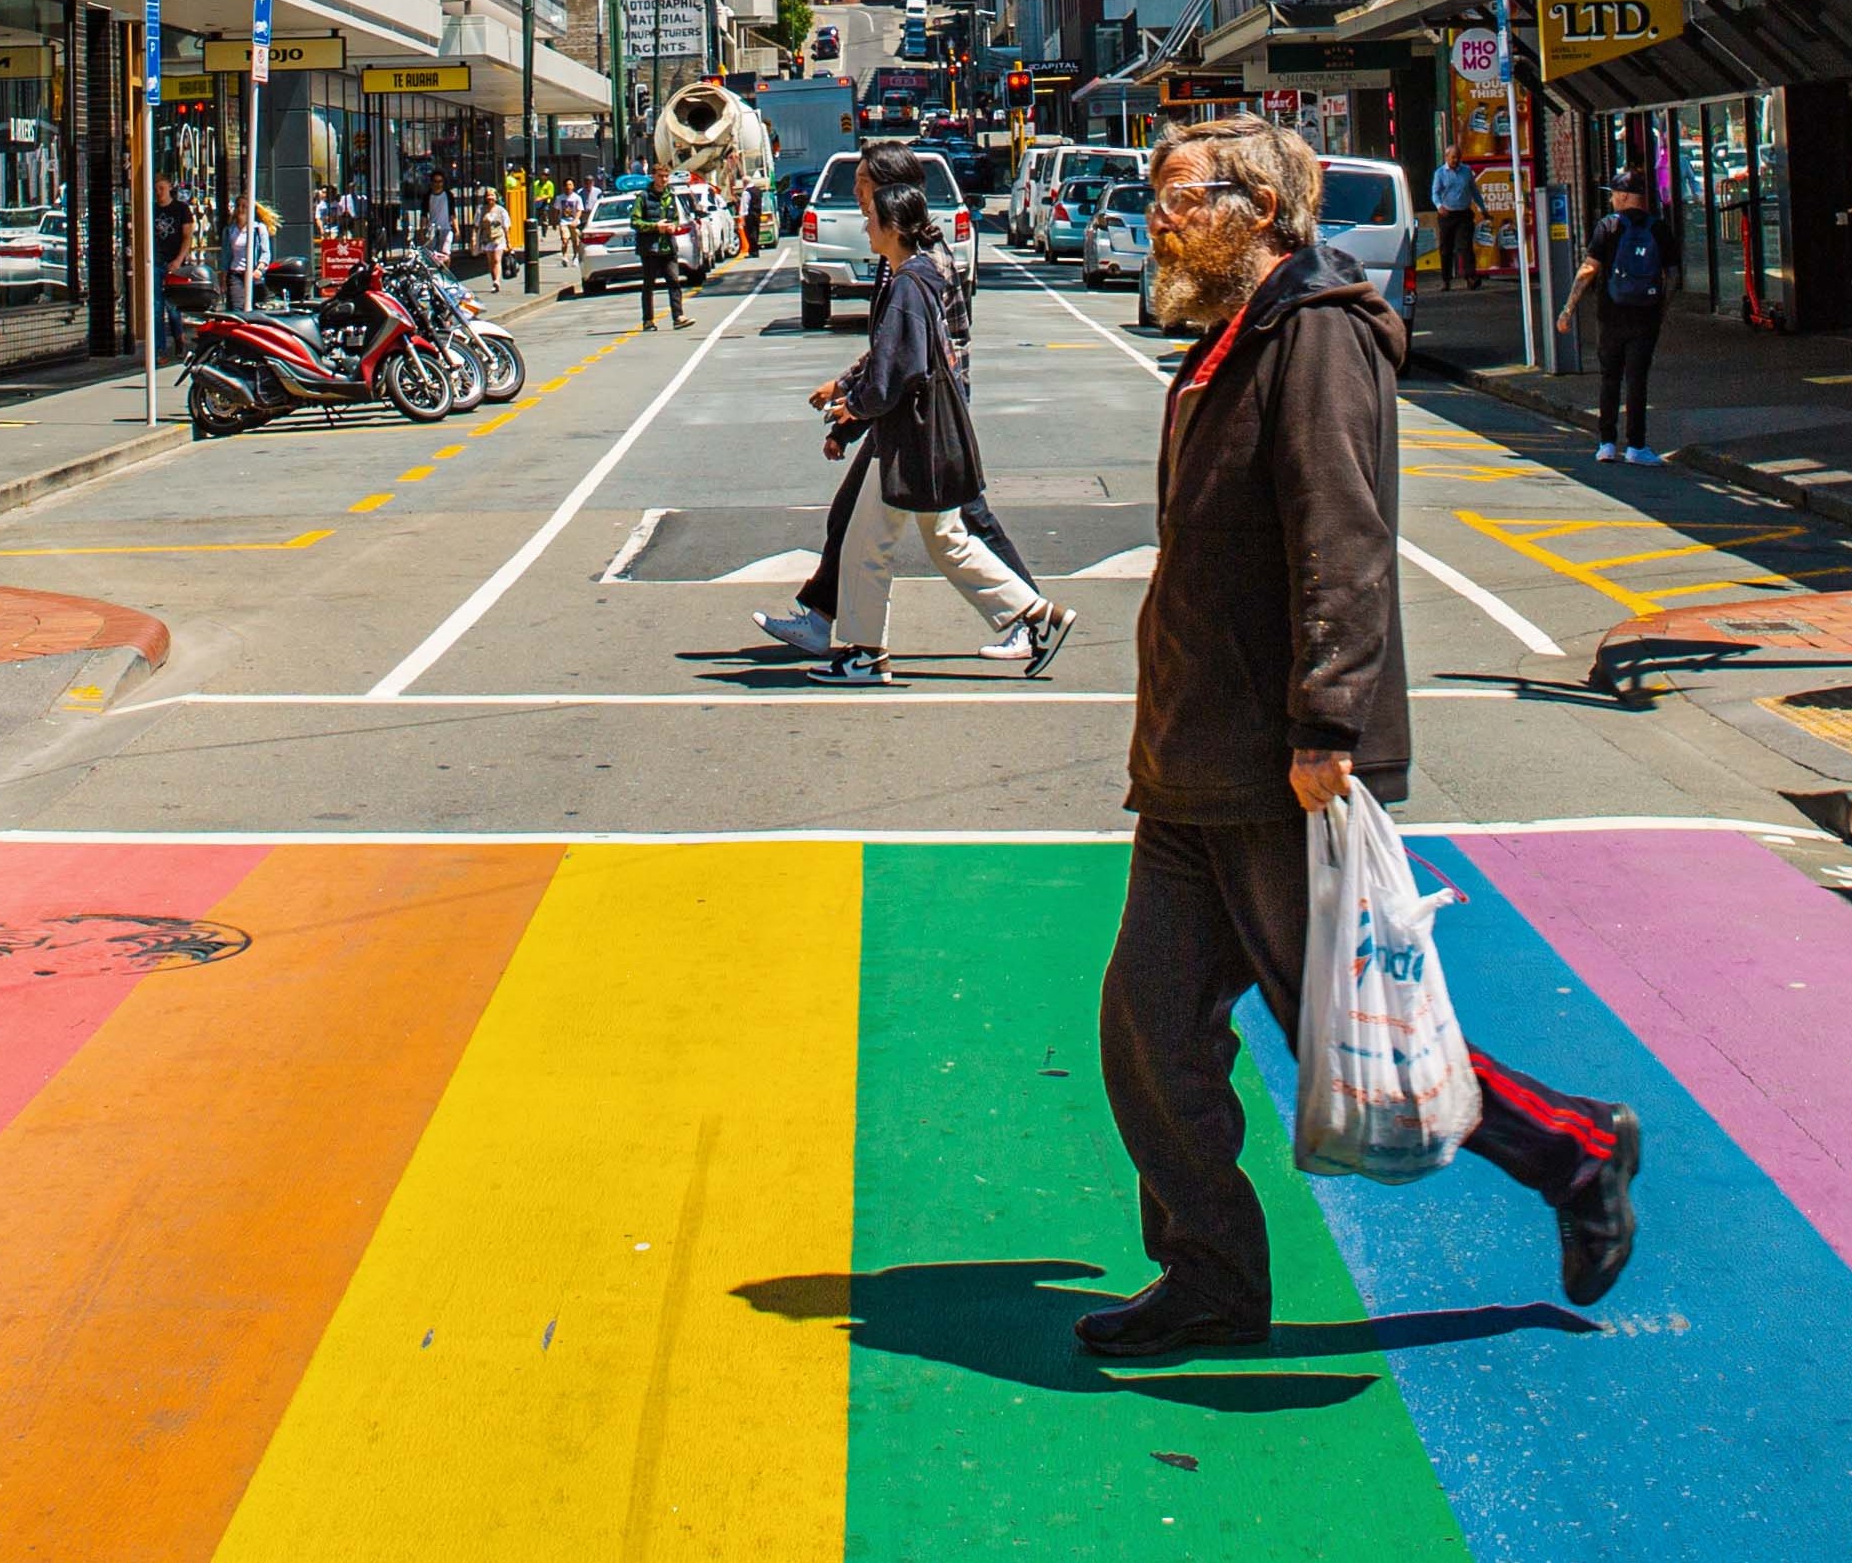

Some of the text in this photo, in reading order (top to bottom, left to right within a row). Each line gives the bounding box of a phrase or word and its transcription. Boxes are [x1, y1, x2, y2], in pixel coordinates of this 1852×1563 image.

[1548, 0, 1660, 42] LTD.
[1461, 40, 1497, 56] PHO
[1462, 55, 1492, 71] MO
[393, 74, 405, 88] TE
[1481, 183, 1509, 192] FEED
[1551, 199, 1565, 215] P
